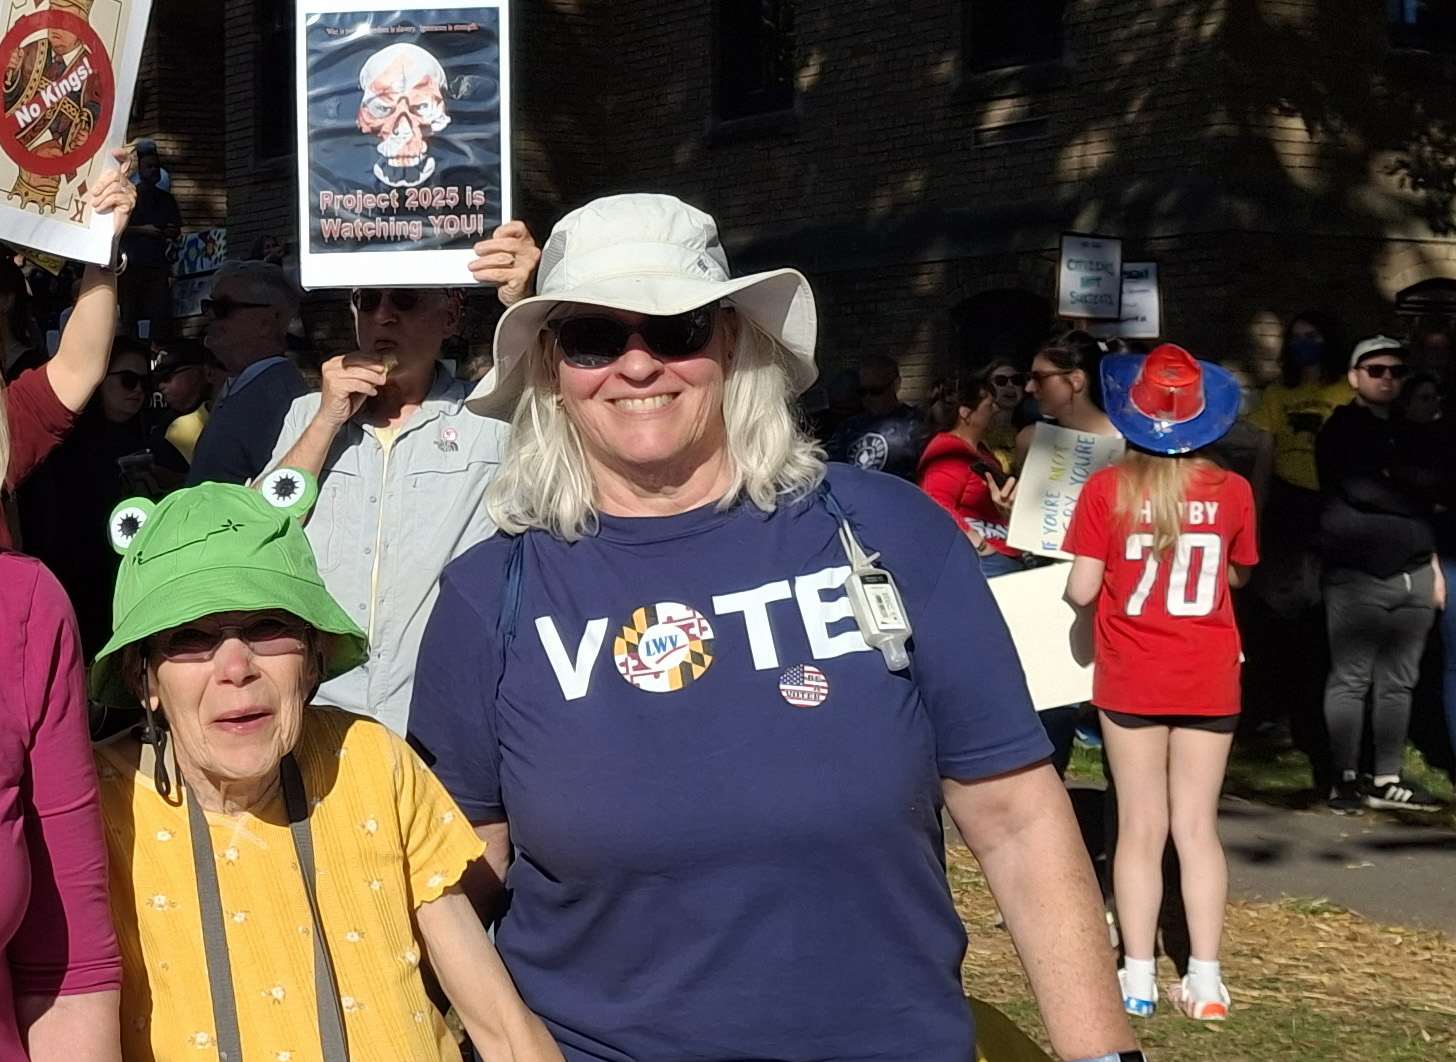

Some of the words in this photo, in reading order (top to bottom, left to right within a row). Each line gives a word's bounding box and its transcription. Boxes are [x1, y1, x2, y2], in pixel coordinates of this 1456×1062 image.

[14, 103, 41, 128] No
[40, 57, 93, 108] Kings!
[319, 189, 399, 216] Project
[405, 187, 459, 209] 2025
[465, 186, 485, 208] is
[320, 217, 422, 241] Watching
[429, 214, 484, 236] YOU!
[1126, 532, 1222, 616] 70
[534, 565, 874, 701] VOTE
[645, 635, 680, 657] LWV
